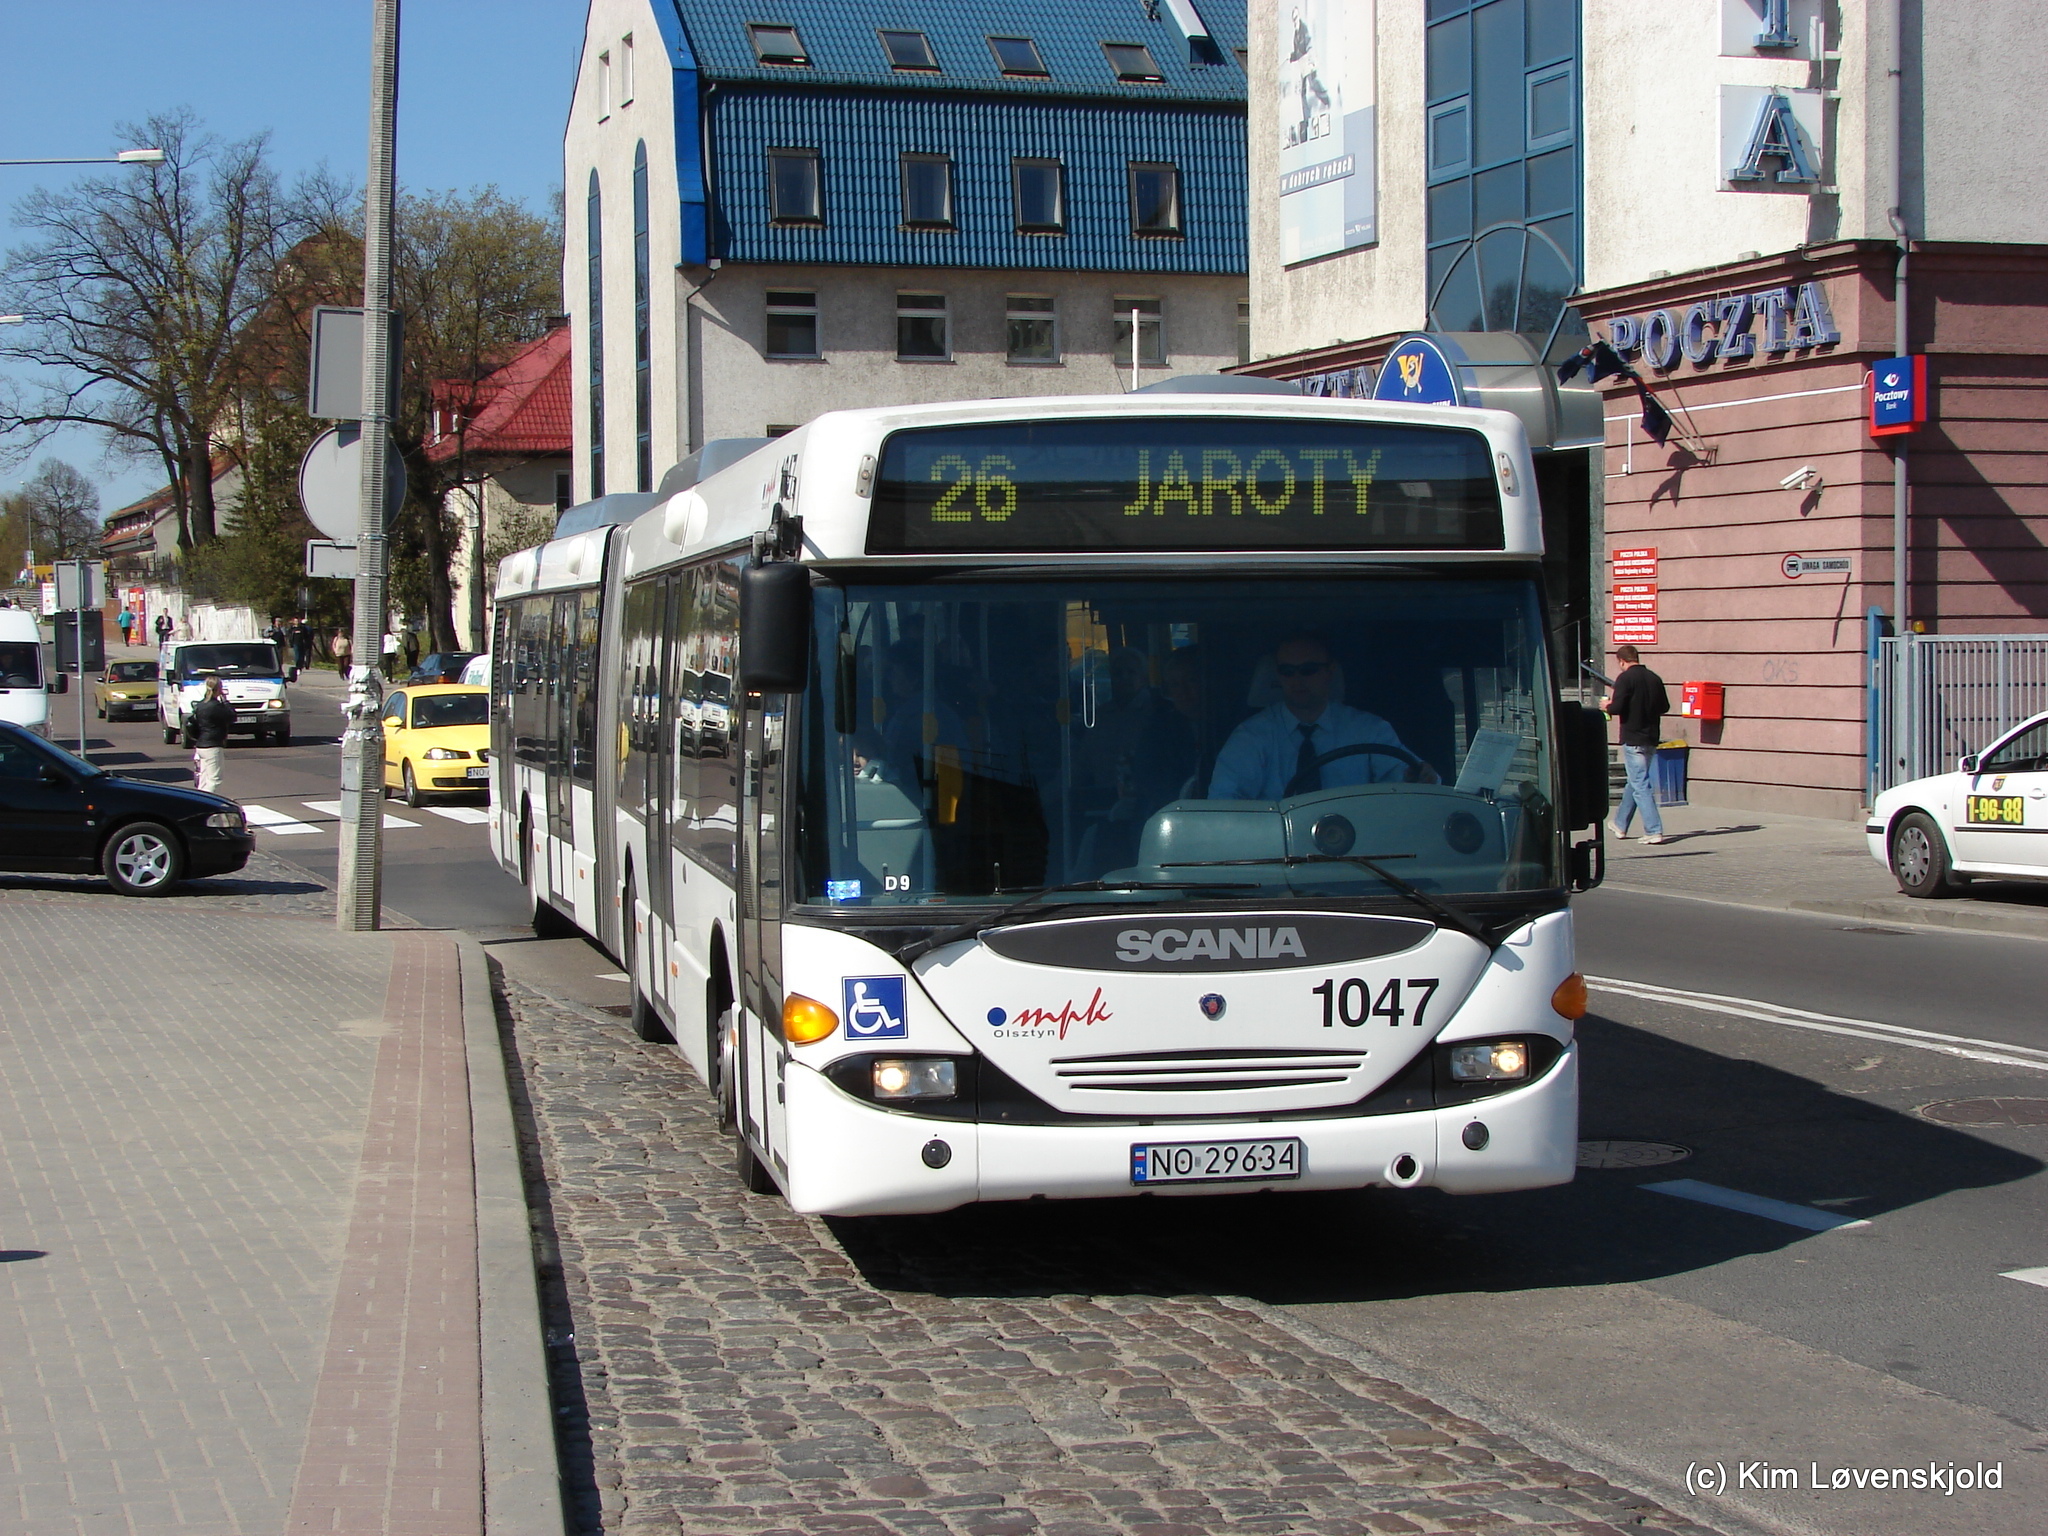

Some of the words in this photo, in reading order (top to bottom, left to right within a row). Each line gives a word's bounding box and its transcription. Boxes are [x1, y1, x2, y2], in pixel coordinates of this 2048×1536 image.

[1289, 166, 1320, 188] dobrych
[1608, 281, 1840, 369] POCZTA
[1874, 389, 1909, 402] Pocztowy
[931, 454, 1016, 522] 26
[1124, 449, 1381, 516] JAROTY
[1967, 796, 2022, 824] 1-96-88
[1115, 926, 1307, 963] SCANIA
[1012, 986, 1114, 1040] mpk
[1312, 977, 1440, 1028] 1047
[993, 1029, 1055, 1038] Olsztyn
[1134, 1166, 1145, 1175] PL
[1152, 1148, 1193, 1177] NO
[1205, 1143, 1295, 1175] 29634
